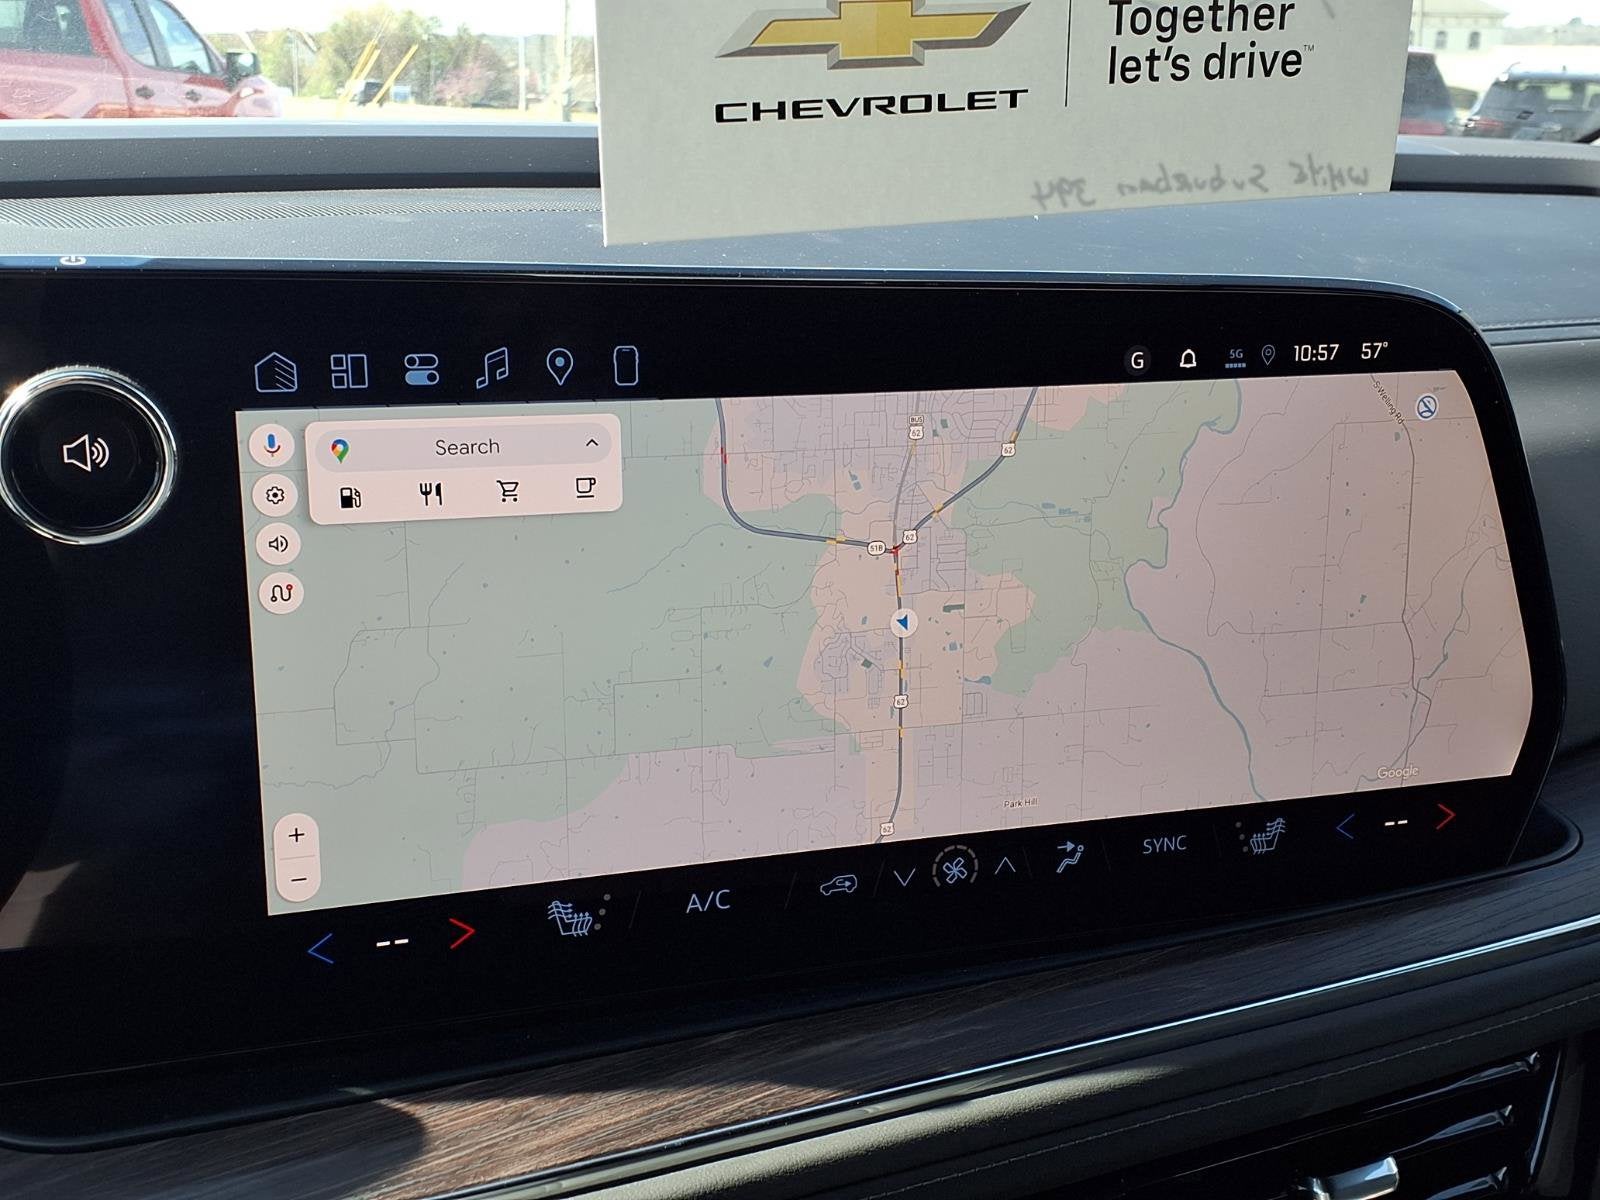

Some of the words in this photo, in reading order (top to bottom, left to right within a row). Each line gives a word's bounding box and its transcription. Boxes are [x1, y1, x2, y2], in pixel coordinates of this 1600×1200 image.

[1109, 0, 1295, 43] Together
[1109, 46, 1190, 84] let's
[715, 89, 1029, 123] CHEVROLET
[1229, 348, 1244, 360] 5G
[1294, 344, 1340, 362] 10:57
[1395, 412, 1405, 425] Rd
[435, 438, 501, 456] Search
[869, 543, 884, 553] 51B
[1377, 764, 1419, 780] Google
[1003, 800, 1023, 808] Park
[1142, 834, 1188, 855] SYNC
[685, 889, 731, 914] A/C
